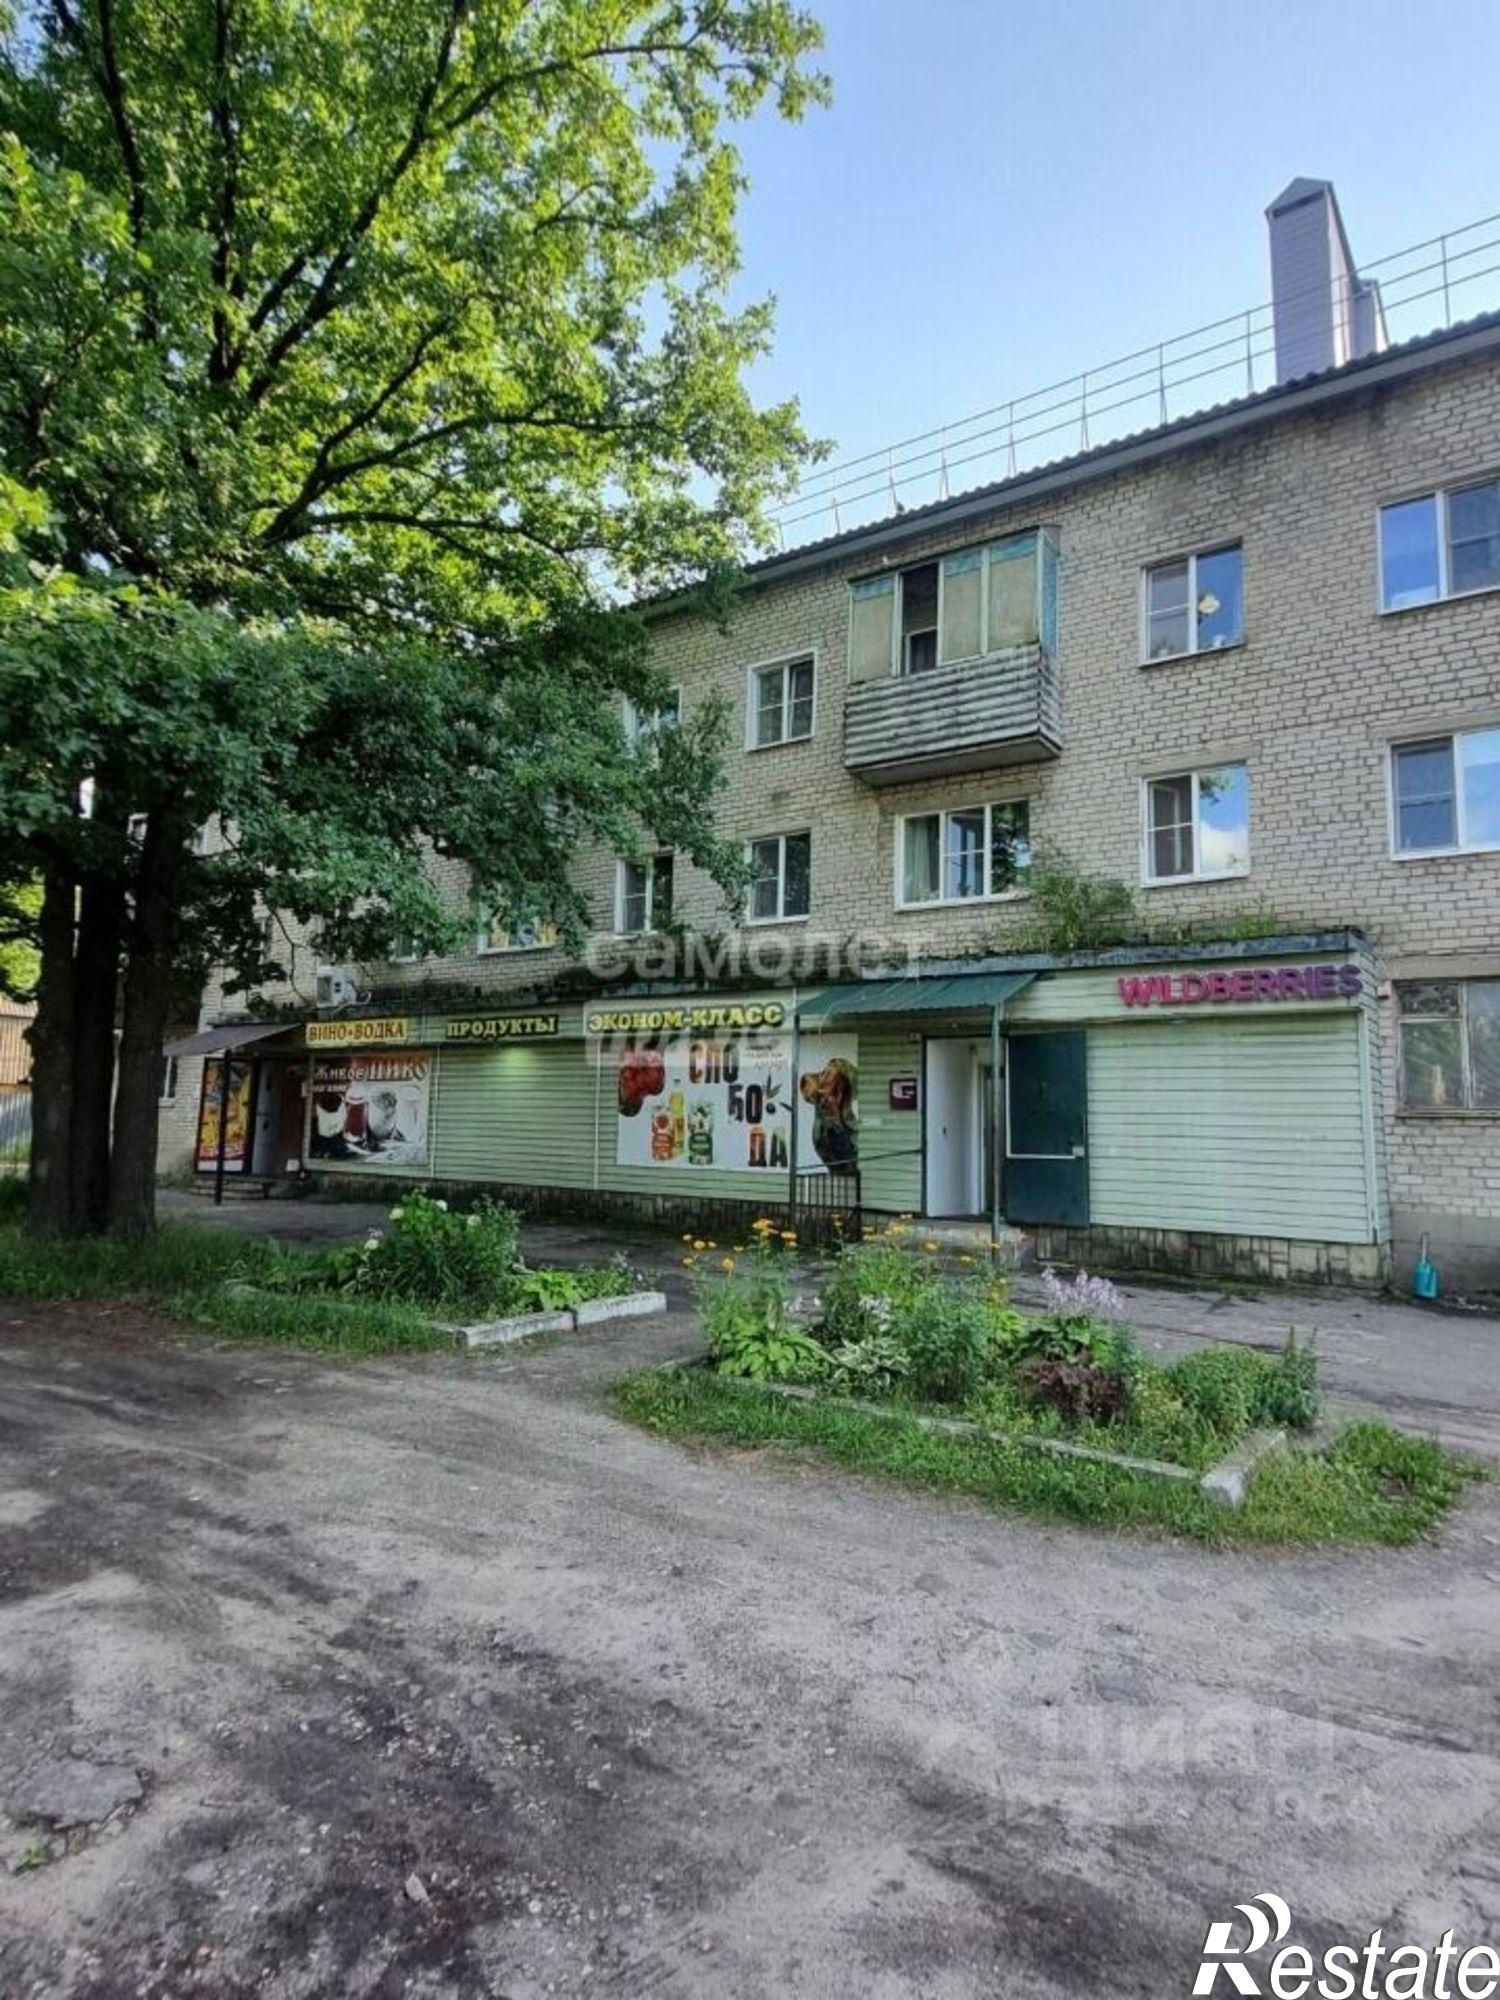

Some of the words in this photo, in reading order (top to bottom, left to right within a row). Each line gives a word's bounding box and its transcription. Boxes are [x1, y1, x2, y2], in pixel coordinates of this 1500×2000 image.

[1117, 964, 1364, 1007] WILDBERRIES
[446, 1016, 557, 1038] ПРОДУКТЫ
[587, 1004, 783, 1033] ЭКОНОМ-КЛАСС
